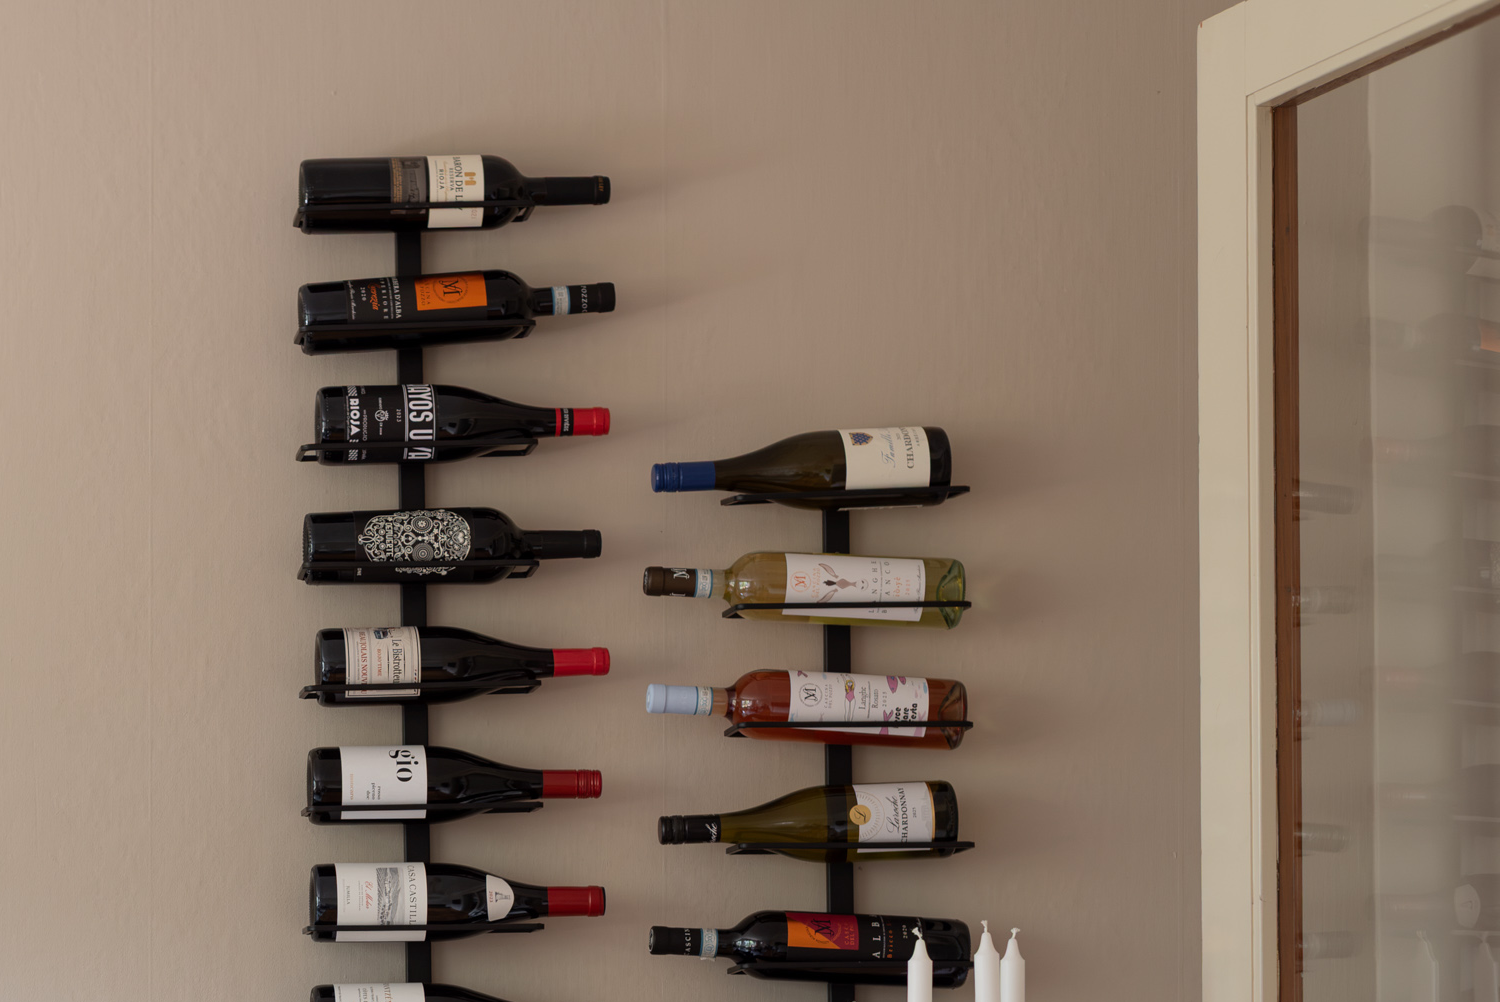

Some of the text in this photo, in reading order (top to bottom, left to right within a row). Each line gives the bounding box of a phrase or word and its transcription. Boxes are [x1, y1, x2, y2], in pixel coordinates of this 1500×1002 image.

[455, 180, 464, 192] DE
[394, 294, 402, 319] D'ALBA
[350, 398, 360, 436] RIOJA
[868, 560, 879, 613] LNGHE
[882, 561, 891, 613] BANCO
[391, 639, 403, 685] Le Bistrotteu
[360, 664, 368, 695] NOUVU
[858, 687, 869, 710] Langhe
[871, 689, 879, 709] Rosato
[388, 750, 419, 783] gio
[885, 796, 900, 834] Laroche
[898, 787, 909, 843] CHARDONNAY
[407, 865, 417, 883] CASA
